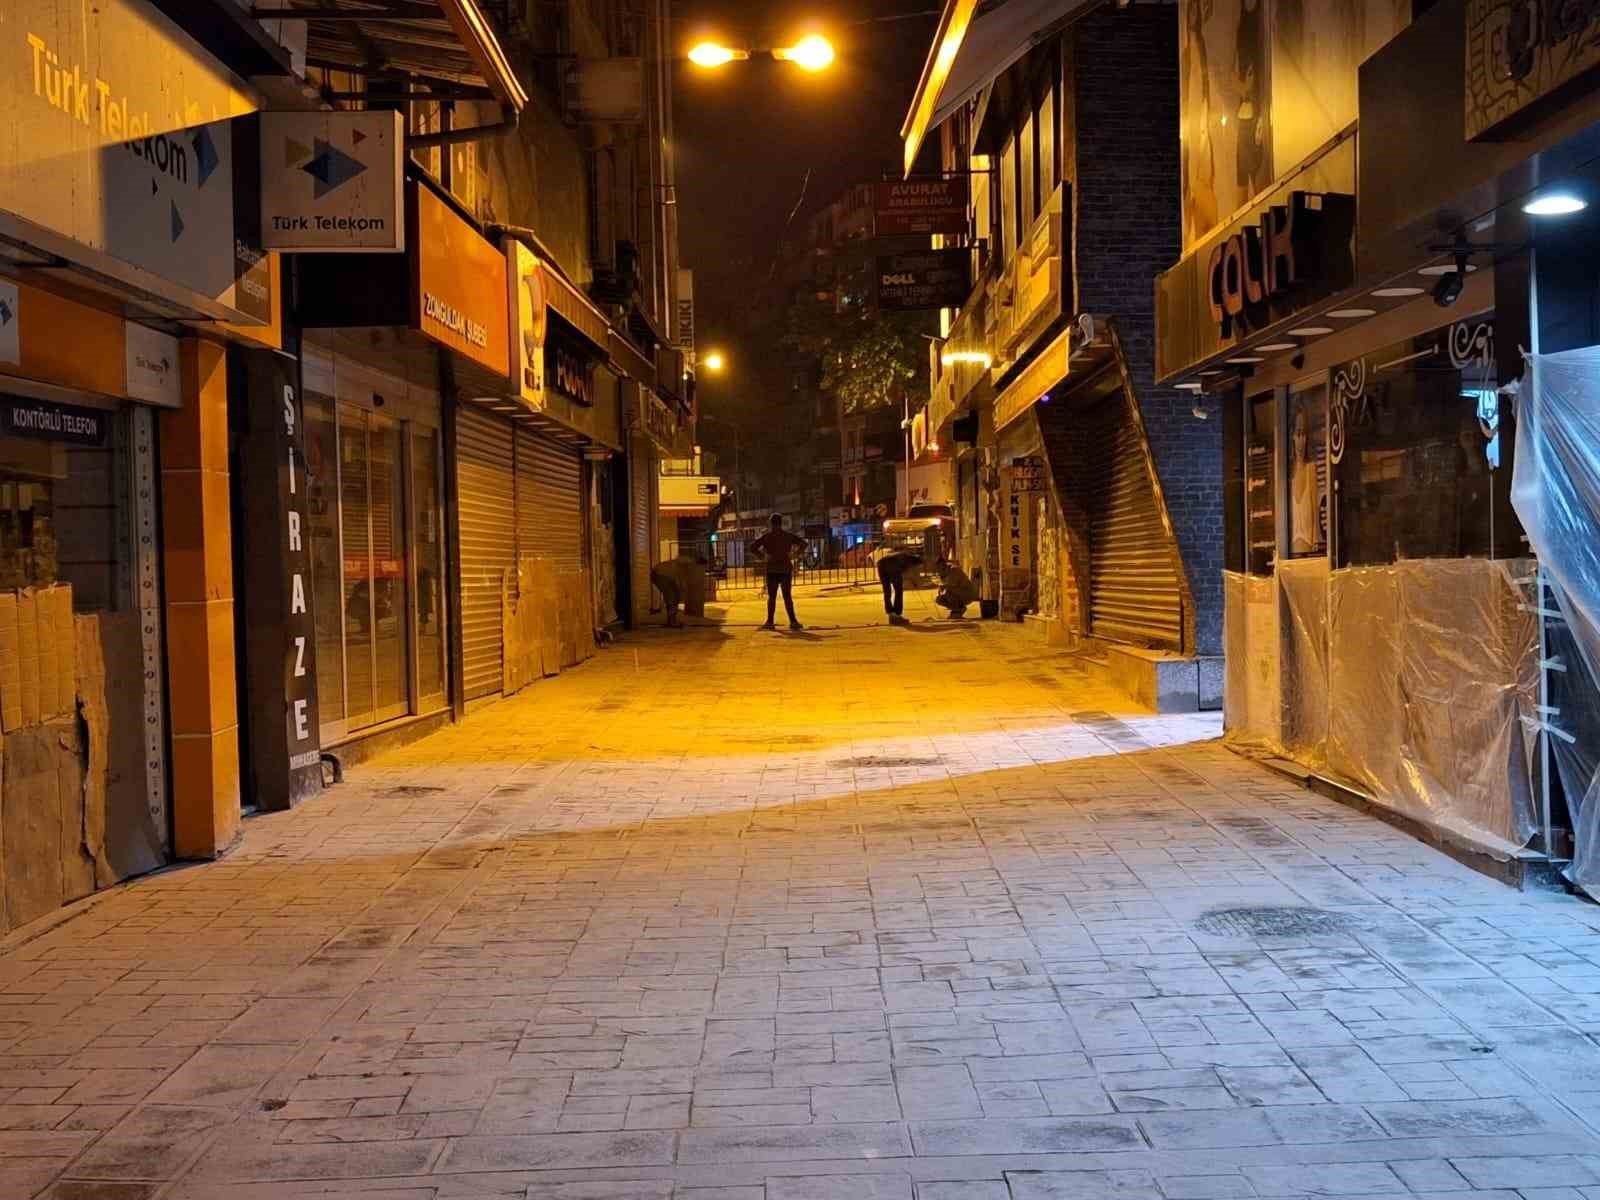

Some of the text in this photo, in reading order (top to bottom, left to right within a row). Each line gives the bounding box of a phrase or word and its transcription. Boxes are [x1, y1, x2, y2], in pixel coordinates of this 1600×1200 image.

[26, 31, 188, 184] Türk Telekom
[271, 215, 385, 231] Türk Telekom
[12, 407, 97, 437] KONTÖRLÜ TELEFON
